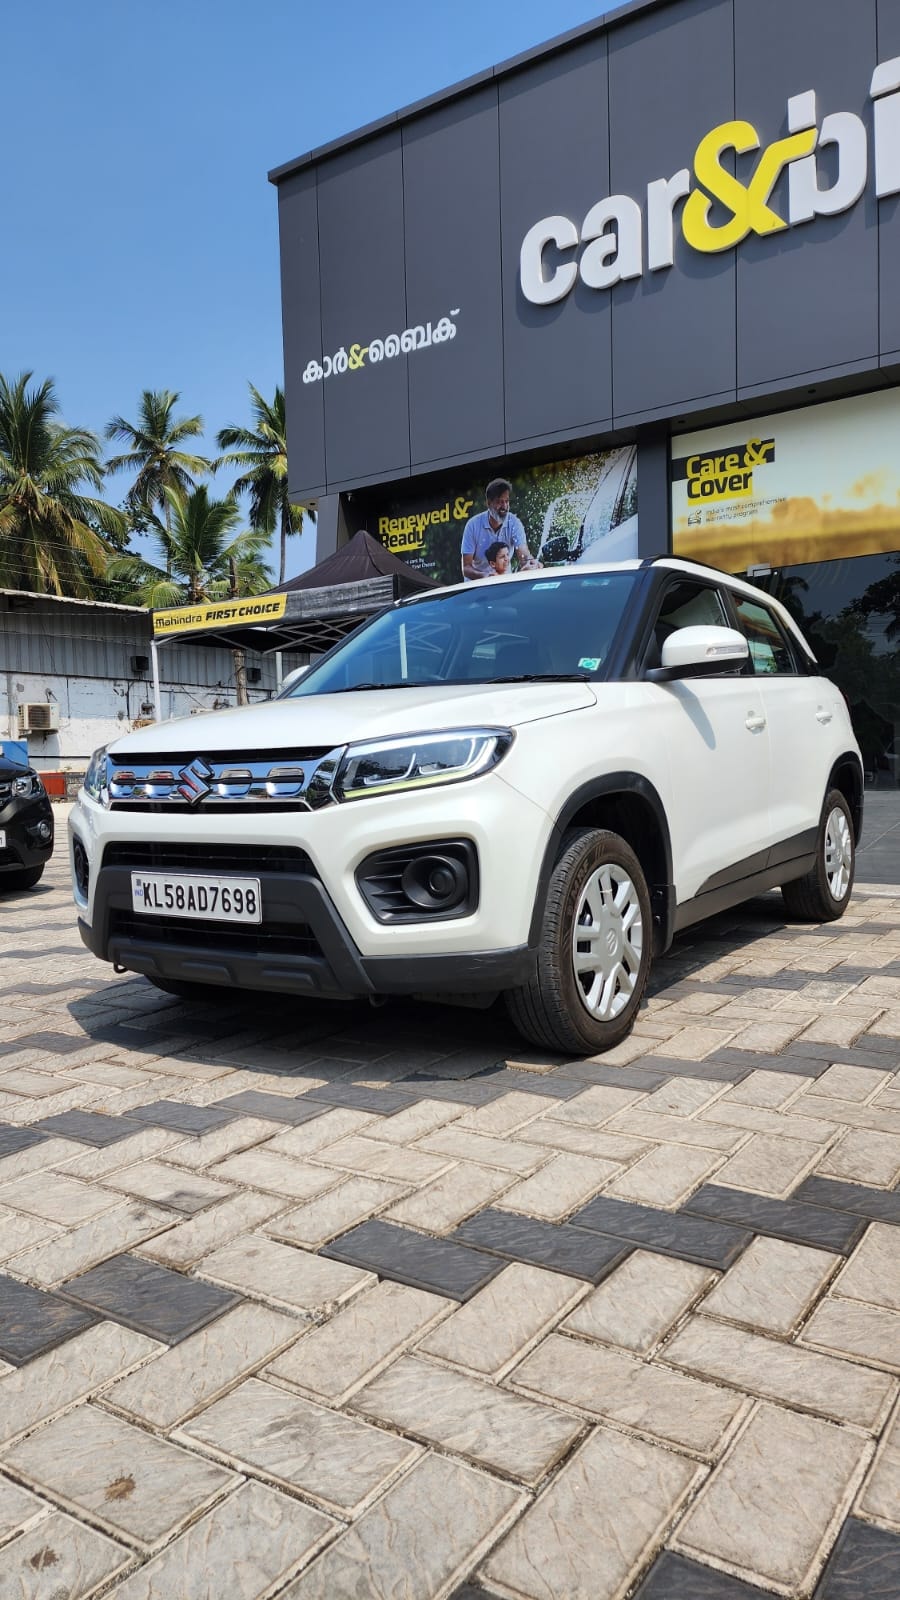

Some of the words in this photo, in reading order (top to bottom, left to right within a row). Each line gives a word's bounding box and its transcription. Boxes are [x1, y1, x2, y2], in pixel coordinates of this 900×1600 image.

[687, 454, 741, 478] Care
[743, 437, 775, 467] &
[688, 472, 752, 498] Cover
[379, 503, 450, 534] Renewed
[453, 496, 473, 520] &
[382, 527, 424, 548] Ready
[155, 614, 202, 628] Mahindra
[205, 608, 238, 621] FIRST
[238, 602, 280, 617] CHOICE
[143, 883, 256, 914] KL58AD7698
